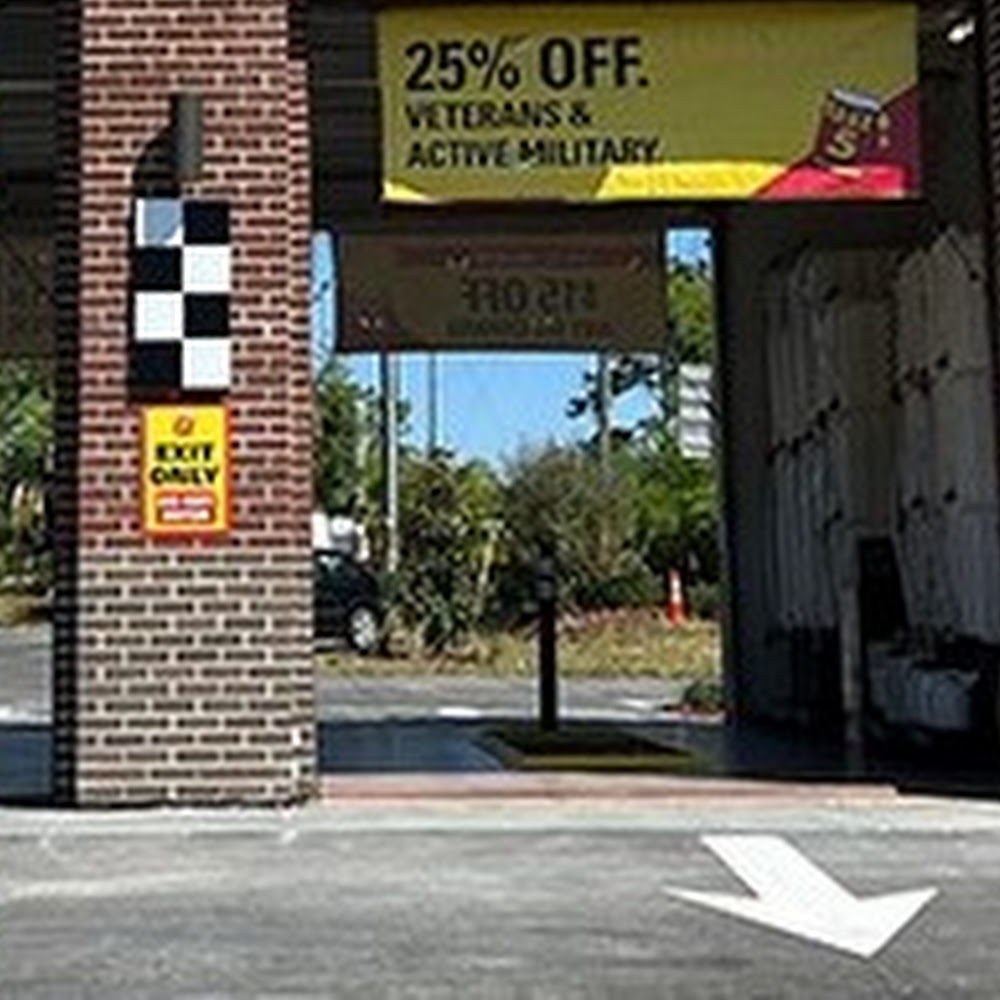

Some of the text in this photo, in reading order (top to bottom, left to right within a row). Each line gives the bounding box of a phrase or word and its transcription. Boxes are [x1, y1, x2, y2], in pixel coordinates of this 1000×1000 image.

[404, 36, 649, 93] 25% OFF.
[405, 100, 592, 131] VETERANS &
[406, 138, 510, 169] ACTIVE
[155, 441, 215, 463] EXIT
[149, 466, 220, 486] ONLY
